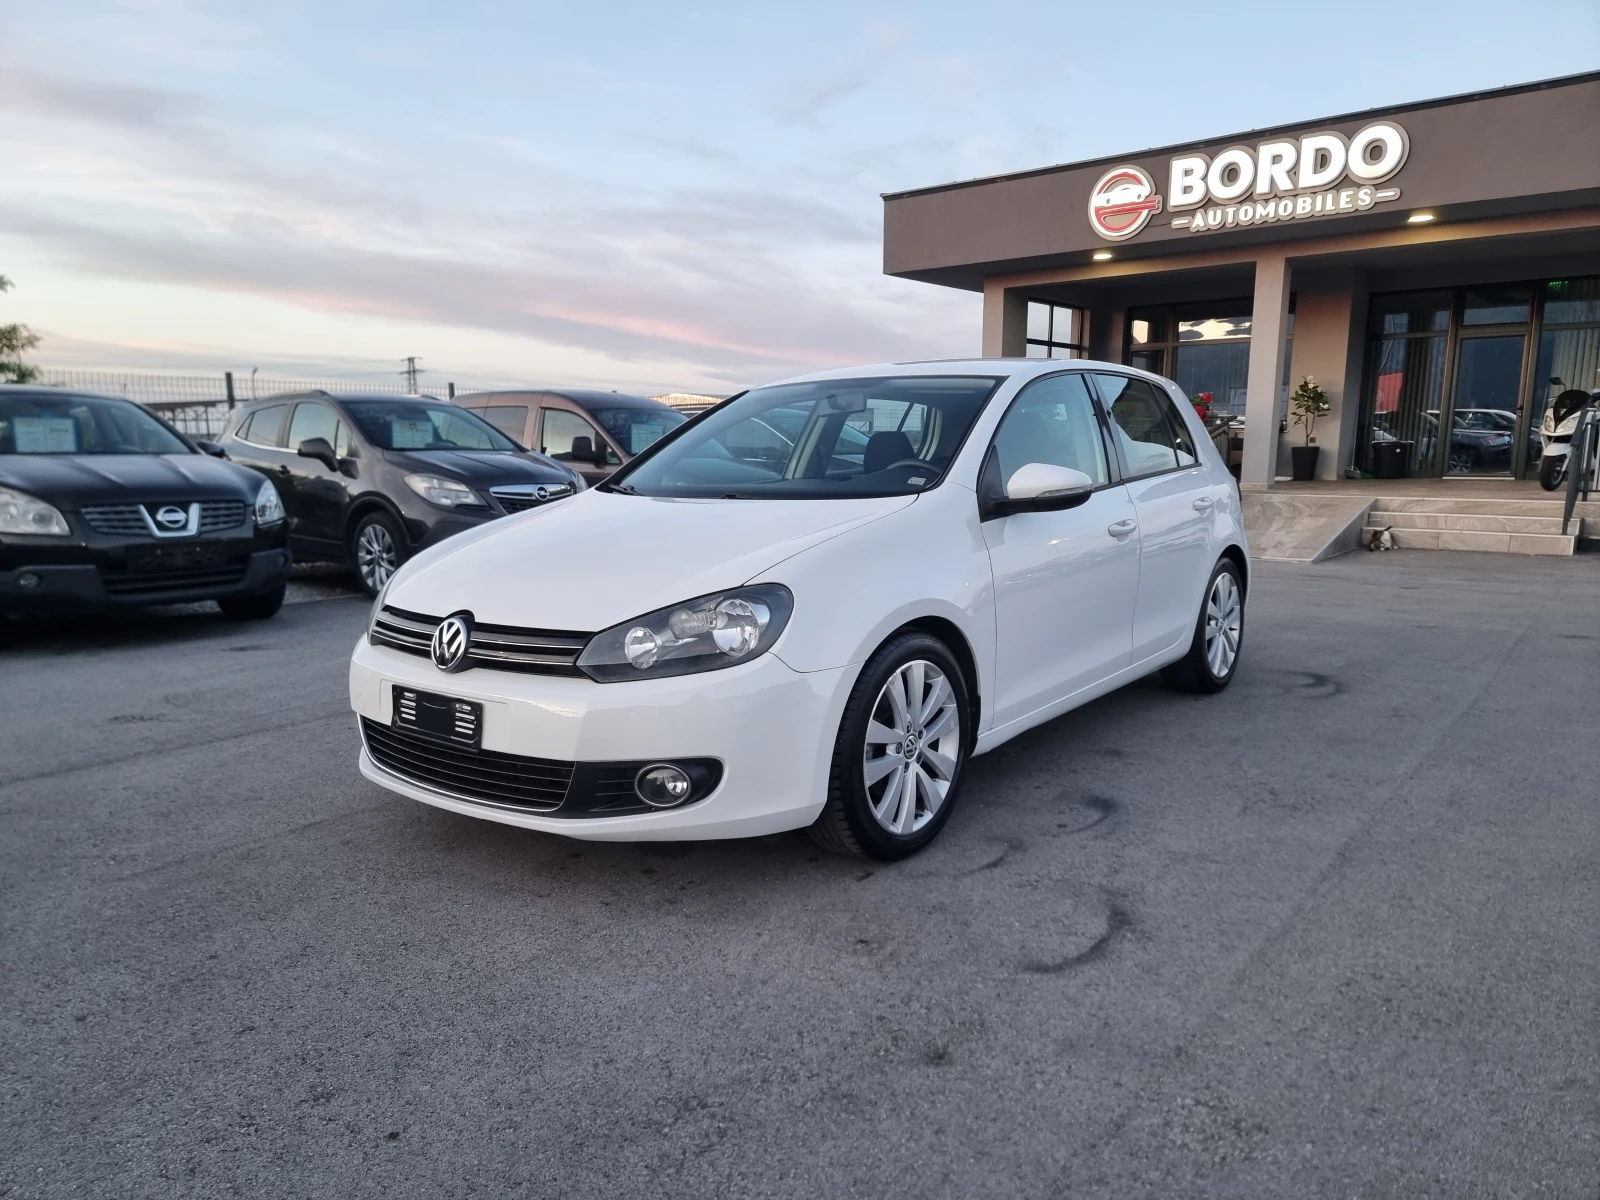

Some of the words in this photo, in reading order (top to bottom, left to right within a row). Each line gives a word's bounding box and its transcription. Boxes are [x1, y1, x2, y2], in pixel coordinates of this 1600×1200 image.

[1170, 125, 1404, 206] BORDO
[1192, 188, 1372, 228] AUTOMOBILES
[433, 618, 465, 668] VW
